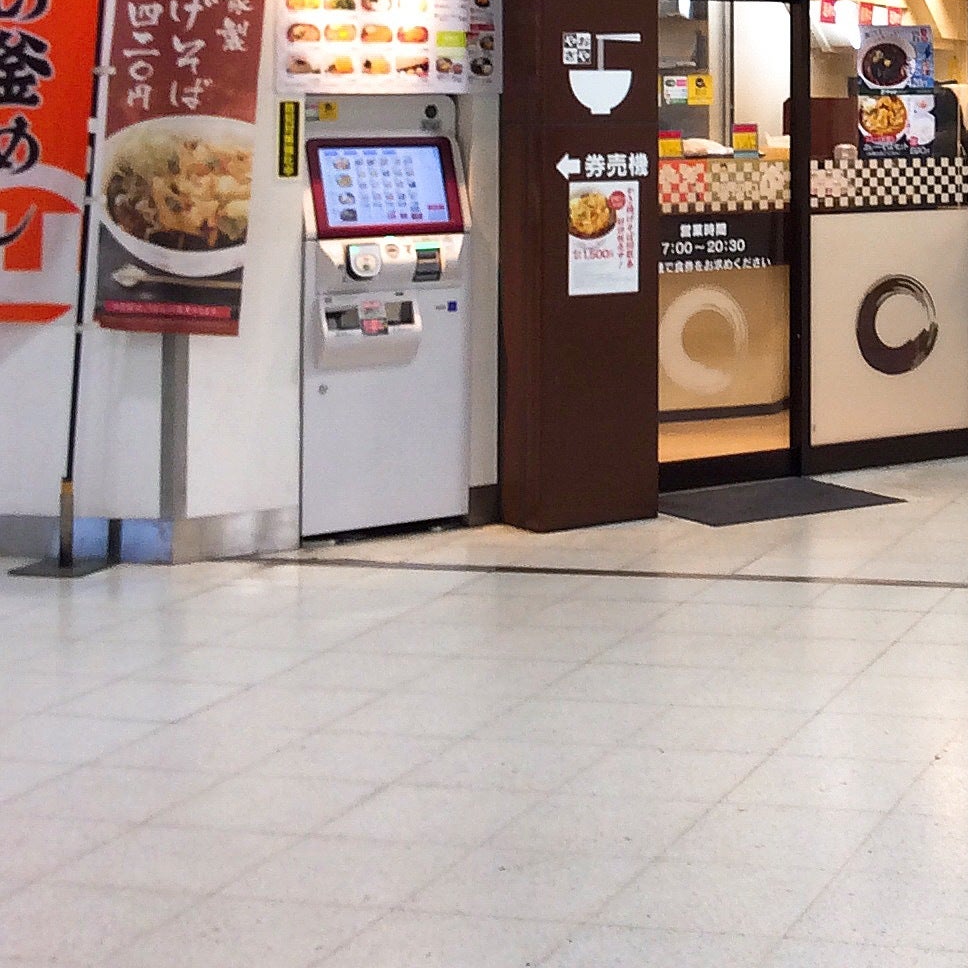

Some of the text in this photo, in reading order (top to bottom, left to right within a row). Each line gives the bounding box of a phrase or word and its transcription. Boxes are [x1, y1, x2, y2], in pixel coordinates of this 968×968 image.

[584, 152, 650, 179] 券売機
[680, 222, 728, 238] 営業時間
